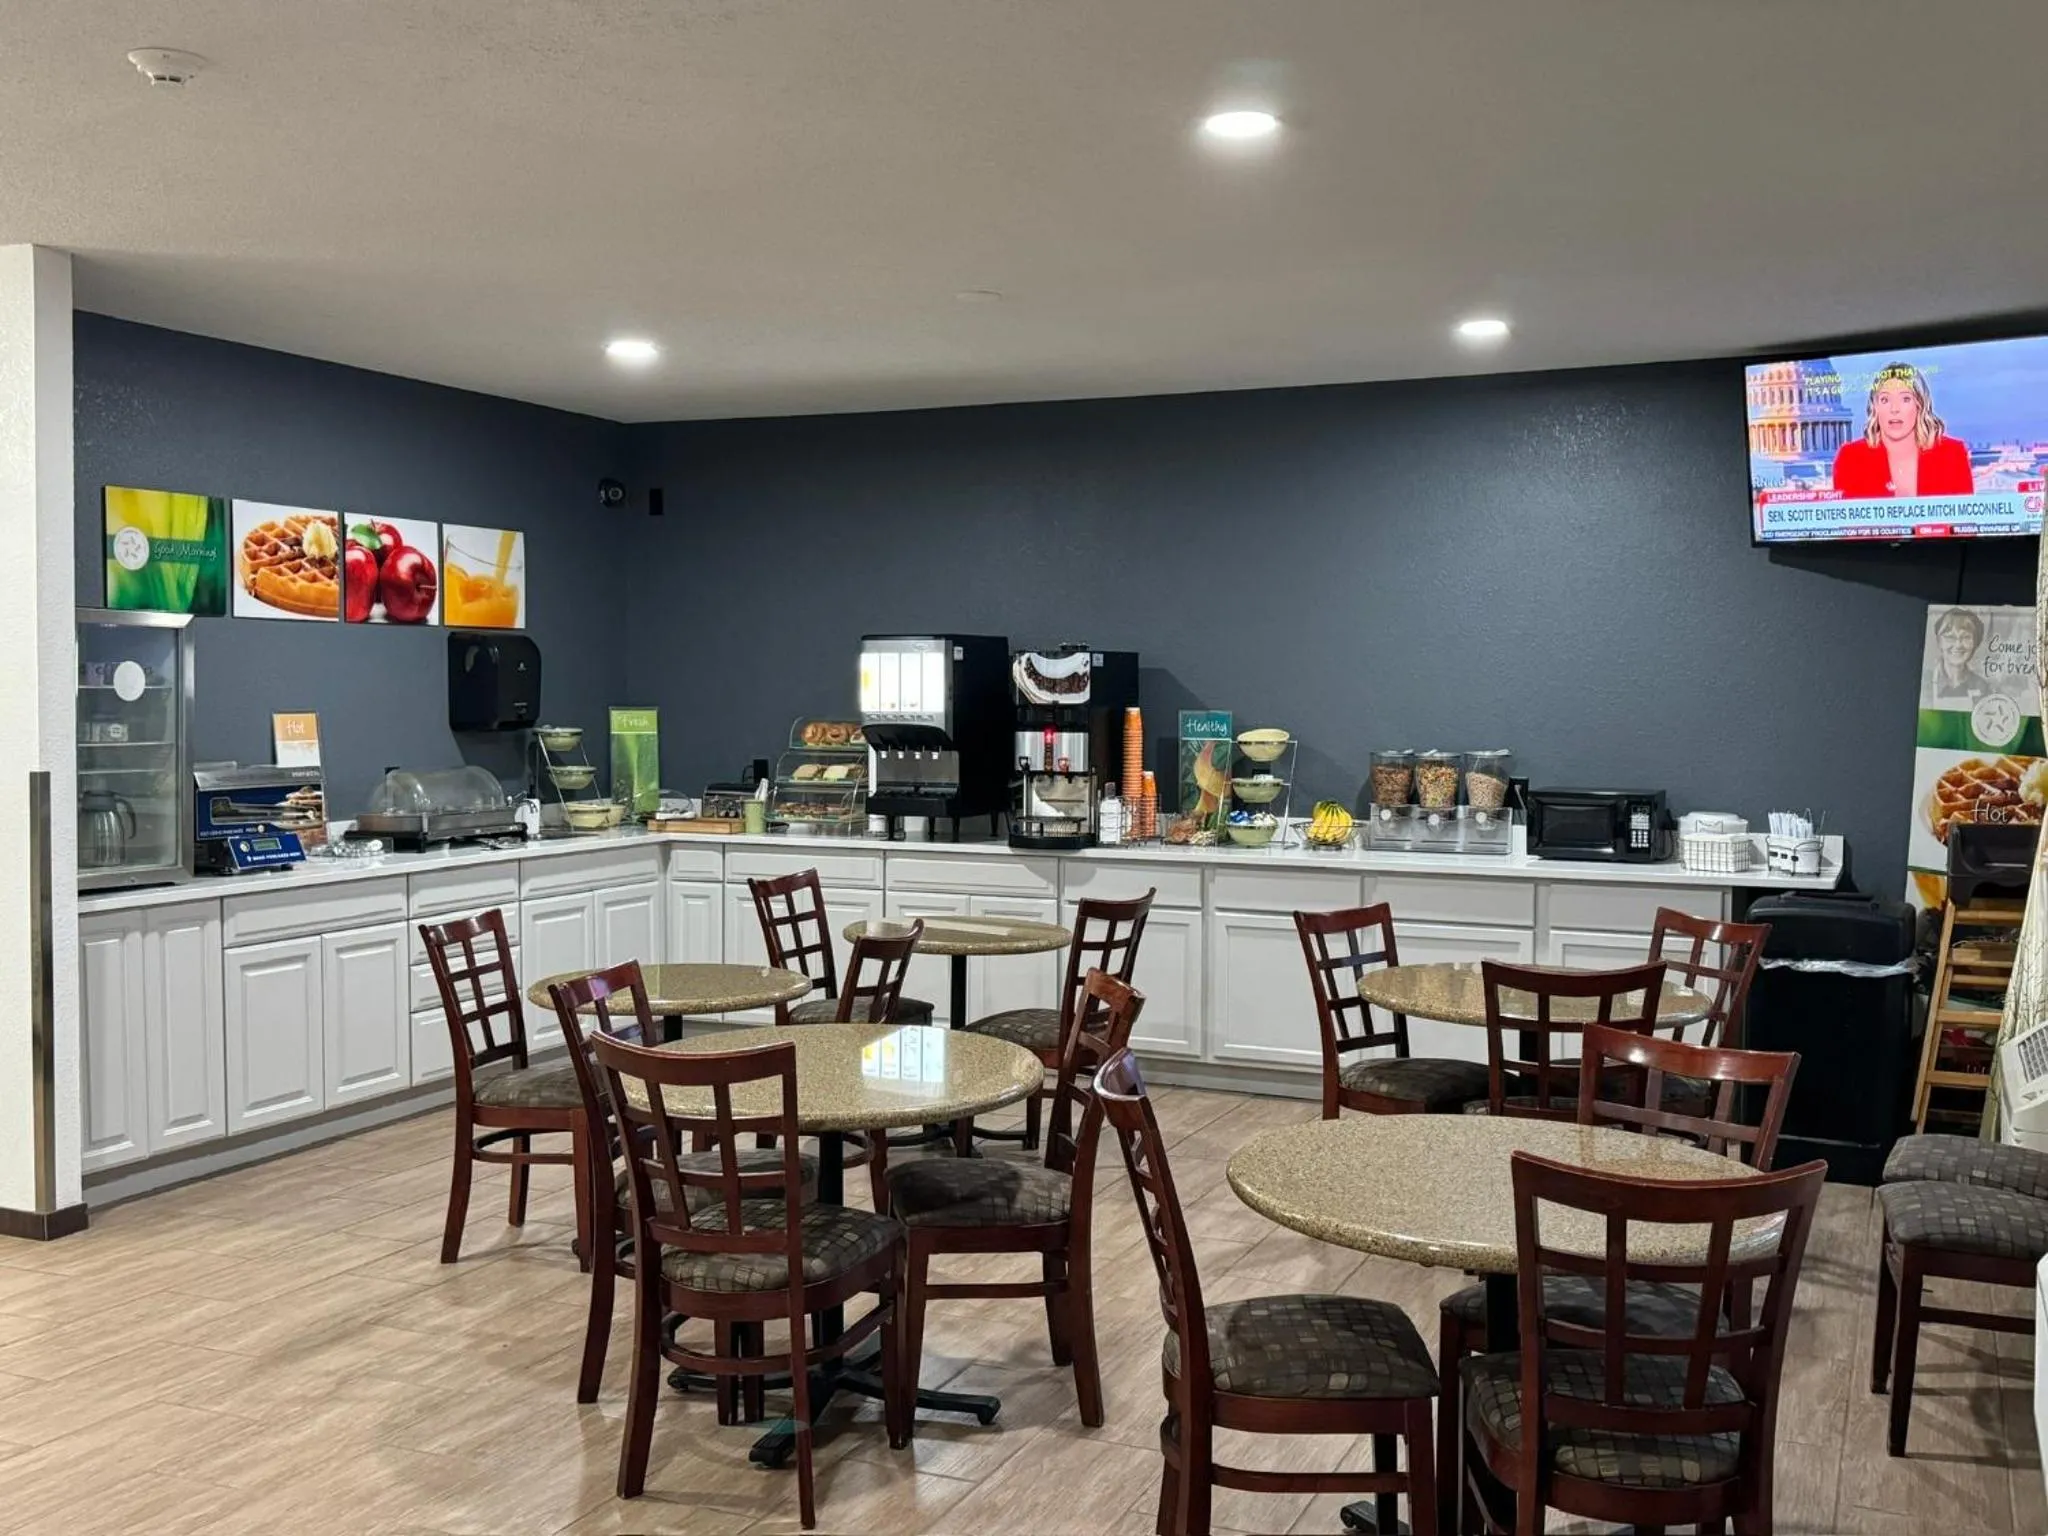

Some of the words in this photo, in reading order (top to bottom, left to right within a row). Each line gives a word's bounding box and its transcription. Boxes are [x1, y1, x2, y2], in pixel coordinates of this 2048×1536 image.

[1768, 493, 1817, 502] LEADERSHIP
[1818, 491, 1844, 500] FIGHT
[1767, 510, 1786, 522] SEN.
[1788, 509, 1814, 522] SCOTT
[1816, 507, 1848, 521] ENTERS
[1849, 507, 1871, 520] RACE
[1872, 506, 1885, 519] TO
[1887, 505, 1925, 518] REPLACE
[1928, 503, 1956, 517] MITCH
[1958, 502, 2015, 516] MCCONNELL
[1988, 634, 2023, 653] Come
[1983, 656, 2005, 678] for
[1186, 717, 1227, 737] Healthy
[1972, 798, 2009, 824] Hot
